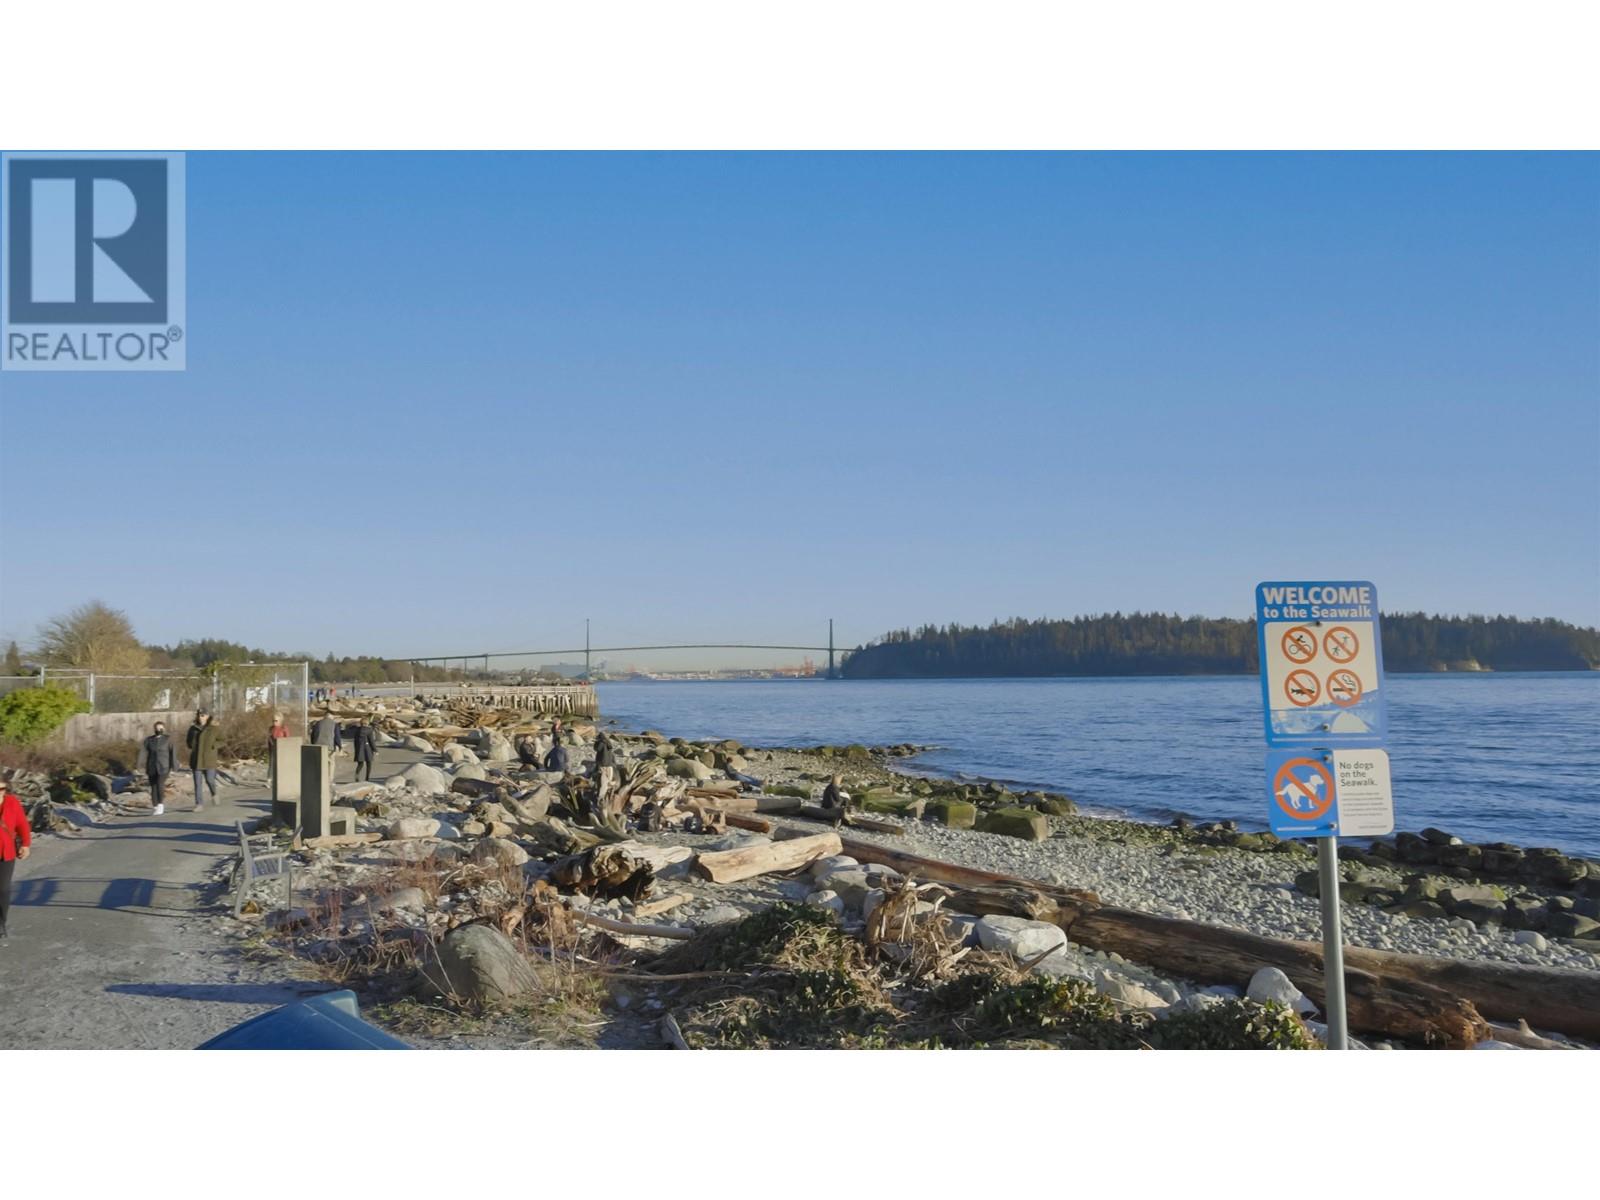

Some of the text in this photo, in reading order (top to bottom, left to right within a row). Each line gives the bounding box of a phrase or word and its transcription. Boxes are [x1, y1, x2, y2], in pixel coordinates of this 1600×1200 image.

[1262, 587, 1371, 604] WELCOME
[1263, 605, 1372, 618] to the Seawalk
[1354, 761, 1374, 770] dogs
[1352, 770, 1367, 778] the
